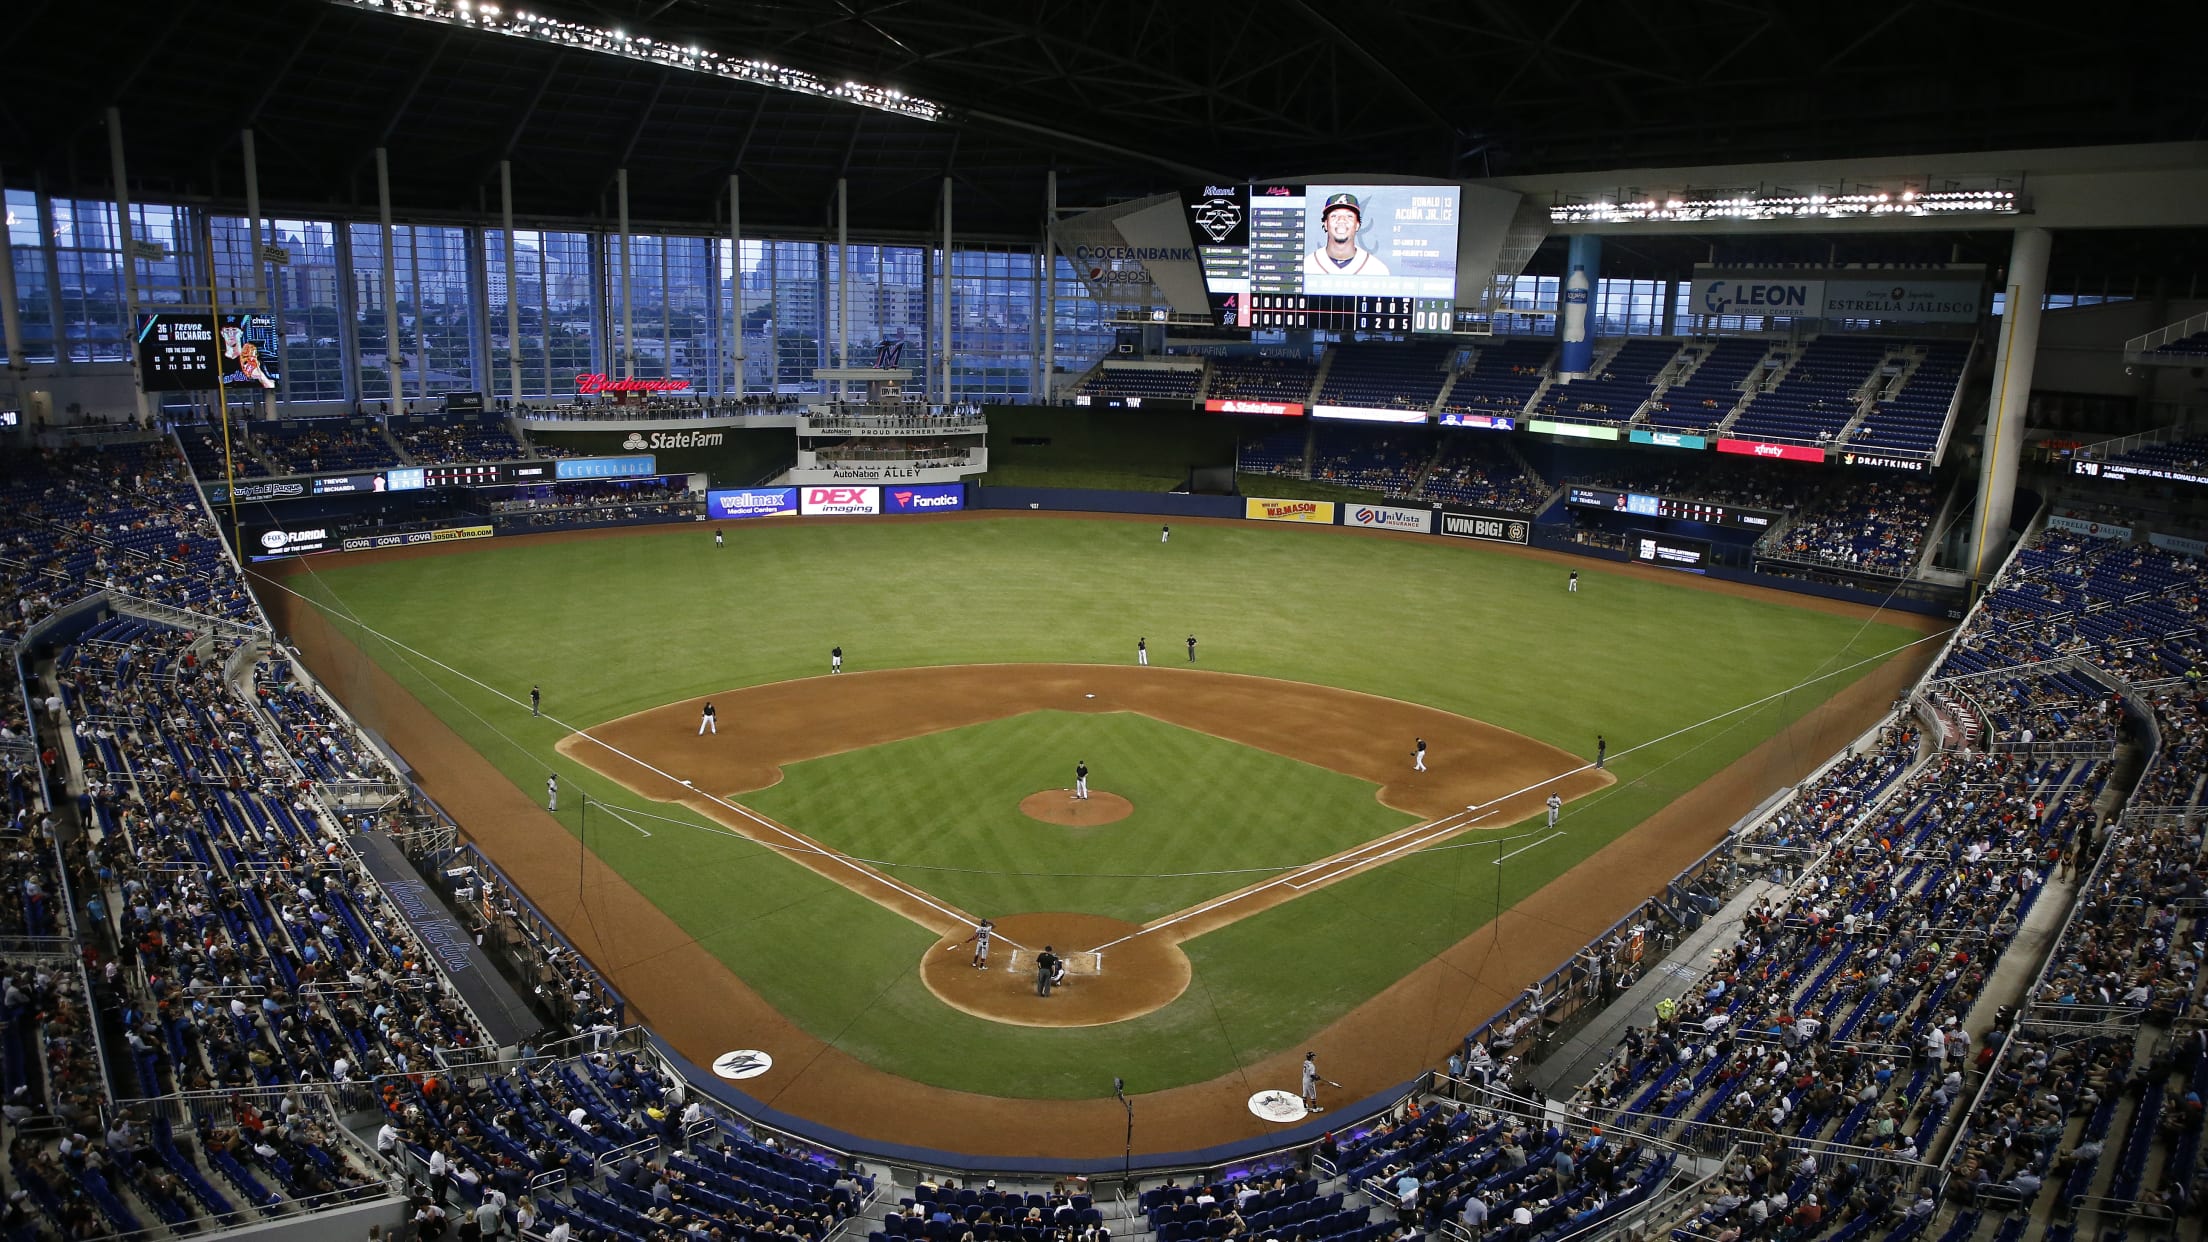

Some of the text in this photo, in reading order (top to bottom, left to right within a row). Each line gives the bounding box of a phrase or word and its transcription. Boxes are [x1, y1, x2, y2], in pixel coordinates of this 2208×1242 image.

[1094, 247, 1191, 260] OCEANBANK
[1107, 270, 1150, 282] pepsi
[1735, 285, 1806, 306] LEON
[1403, 303, 1409, 313] 5
[1828, 299, 1974, 313] ESTRELLA JALISCO
[175, 323, 203, 331] TREVOR
[1375, 318, 1381, 329] 2
[1402, 319, 1409, 330] 5
[175, 331, 212, 341] RICHARDS
[575, 373, 691, 393] Budweiser
[1754, 444, 1783, 457] xfinity
[1858, 457, 1922, 470] DRAFTKINGS
[833, 469, 920, 478] AutoNation ALLEY
[2075, 461, 2098, 475] 5:40
[2111, 466, 2138, 474] LEADING
[2173, 473, 2196, 482] RONALD
[252, 485, 264, 495] En
[264, 484, 273, 493] El
[273, 483, 303, 496] Parque
[720, 492, 785, 508] wellmax
[809, 489, 867, 504] DEX
[914, 494, 958, 508] Fanatics
[822, 505, 873, 513] imaging
[1375, 510, 1420, 524] UniVista
[1386, 520, 1419, 528] INSURANCE
[1447, 517, 1474, 534] WIN
[1475, 520, 1503, 537] BIG!
[2052, 518, 2129, 536] ESTRELLA JALISCO
[267, 535, 282, 543] FOX
[346, 533, 431, 549] GOYA GOYA GOYA
